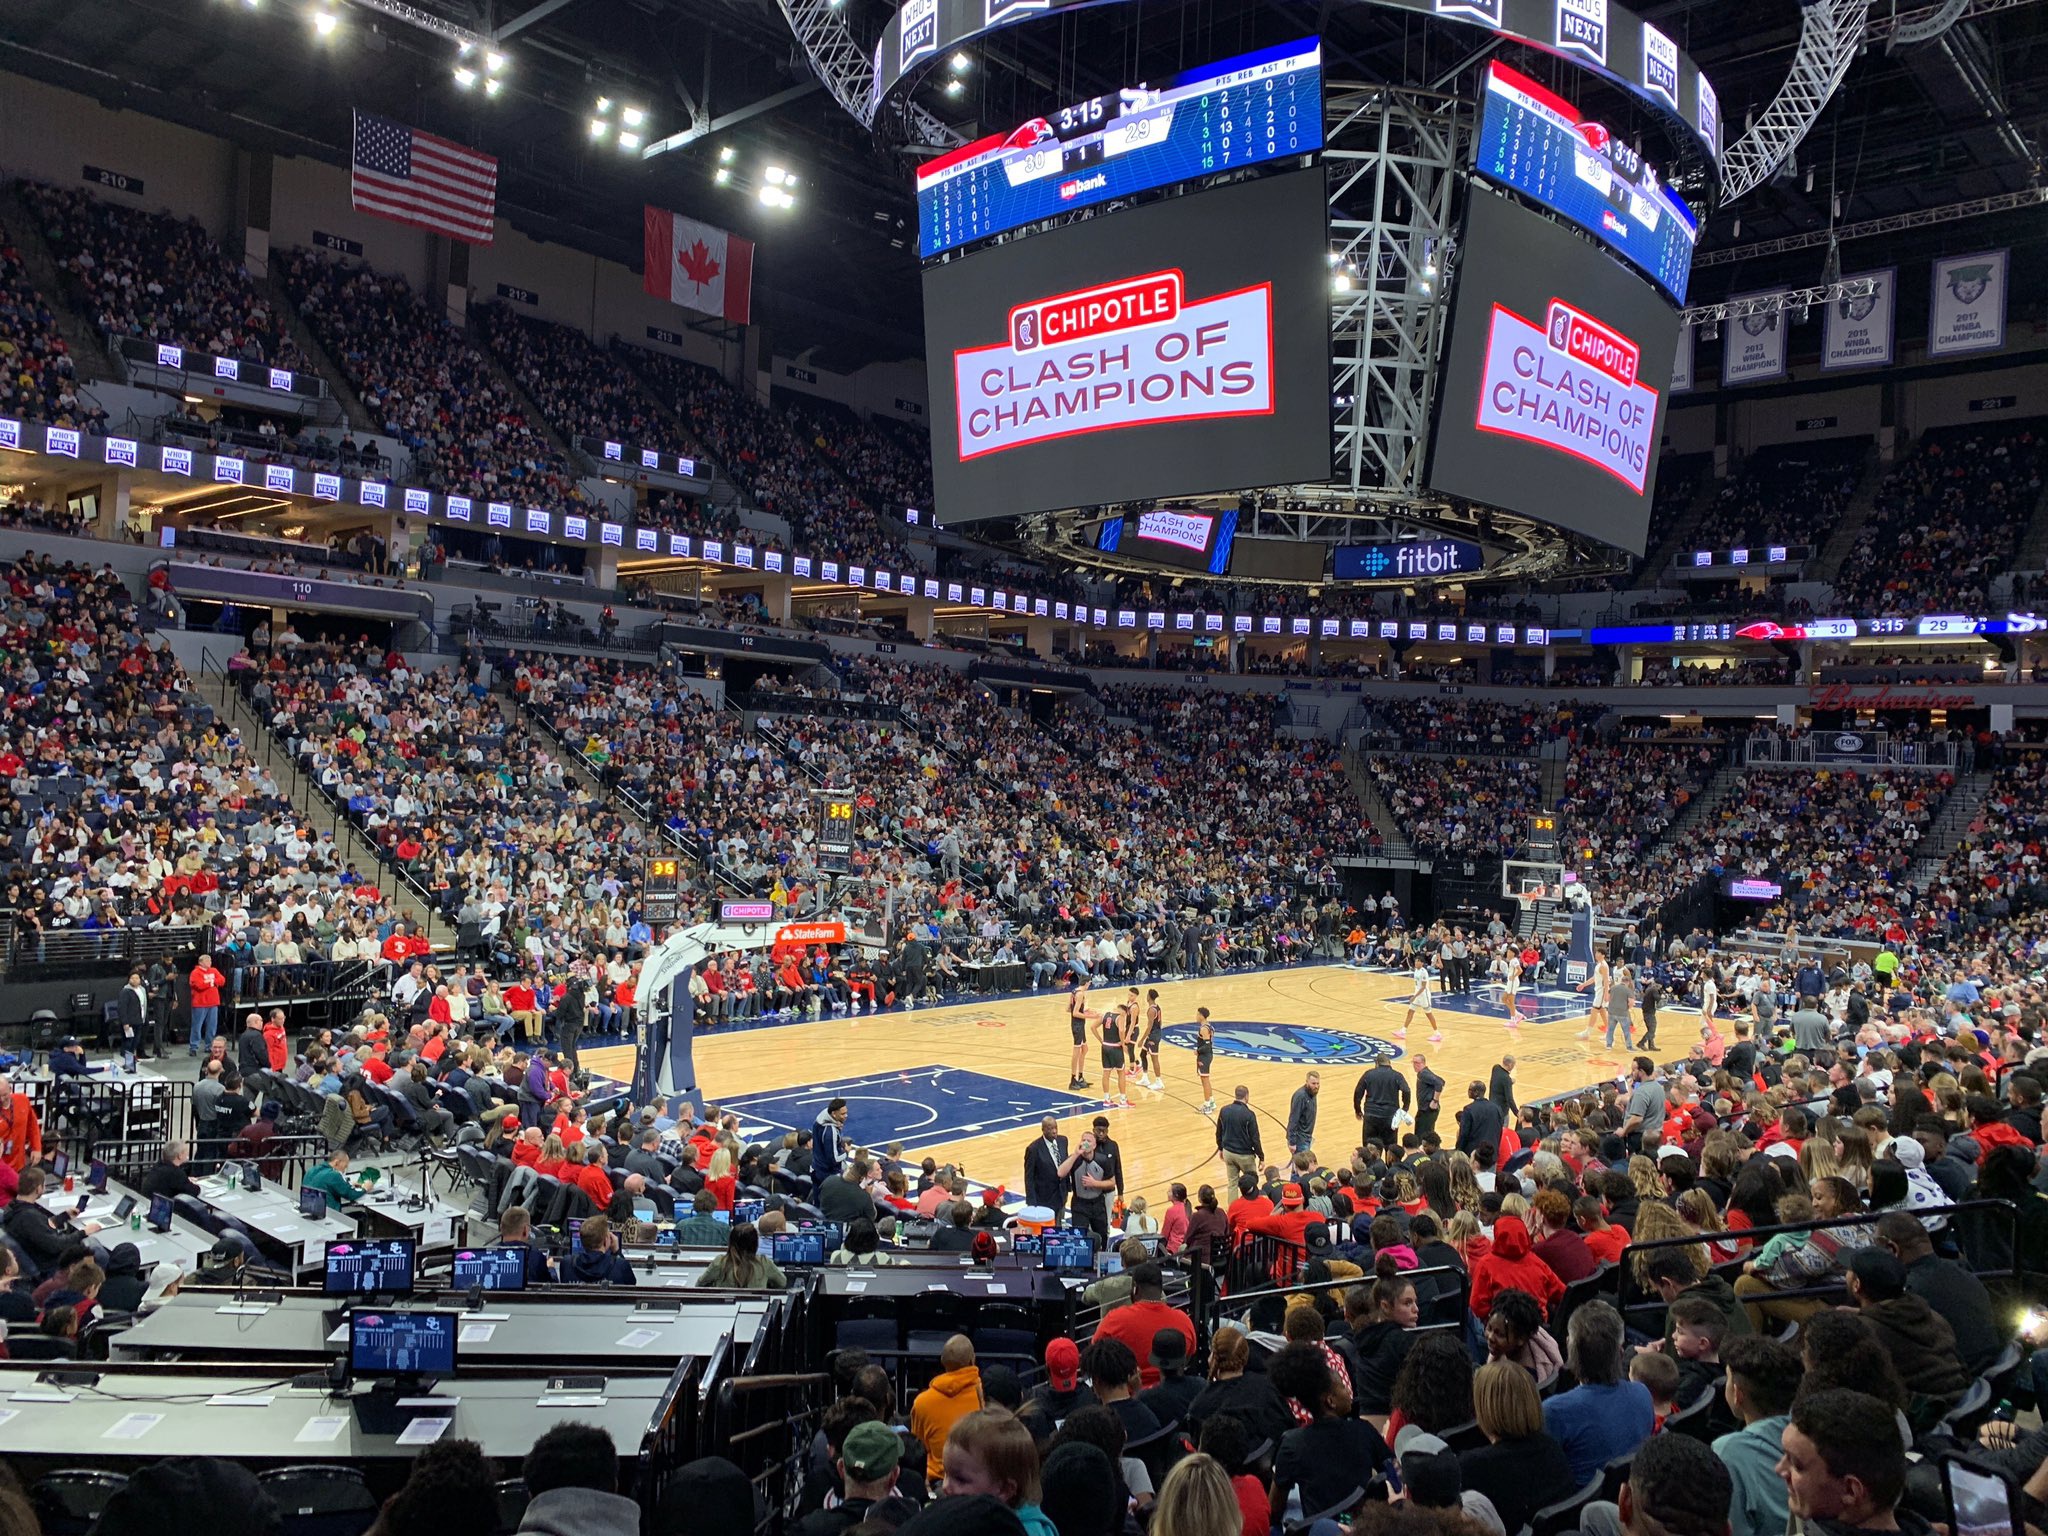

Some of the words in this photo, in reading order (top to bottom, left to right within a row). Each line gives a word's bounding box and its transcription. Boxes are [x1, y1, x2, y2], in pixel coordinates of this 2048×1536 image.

[904, 18, 932, 52] NEXT
[1564, 14, 1601, 45] NEXT
[1650, 32, 1674, 63] WHO'S
[1216, 76, 1232, 86] PTS
[1238, 69, 1253, 80] REB
[1262, 63, 1278, 74] AST
[1286, 58, 1296, 68] PF
[1649, 58, 1674, 90] NEXT
[1201, 96, 1208, 108] 0
[1221, 91, 1229, 103] 2
[1245, 85, 1249, 96] 1
[1266, 79, 1273, 91] 0
[1288, 74, 1295, 85] 0
[1060, 96, 1103, 129] 3:15
[1203, 112, 1208, 123] 1
[1222, 106, 1229, 118] 0
[1244, 101, 1251, 112] 7
[1267, 95, 1272, 107] 1
[1290, 90, 1295, 101] 1
[1203, 127, 1209, 138] 3
[1220, 121, 1232, 134] 13
[1245, 116, 1251, 127] 4
[1266, 111, 1274, 123] 2
[1289, 106, 1296, 117] 0
[1125, 118, 1150, 144] 29
[1202, 141, 1212, 153] 11
[1222, 137, 1229, 149] 0
[1246, 132, 1252, 143] 3
[1267, 126, 1275, 138] 0
[1289, 121, 1296, 132] 0
[1064, 142, 1072, 150] TO
[1092, 133, 1102, 141] TO
[1065, 151, 1070, 160] 3
[1080, 146, 1085, 160] 1
[1097, 142, 1102, 151] 3
[1202, 156, 1213, 169] 15
[1223, 152, 1230, 164] 7
[1246, 147, 1252, 158] 4
[1268, 141, 1275, 154] 0
[1290, 137, 1297, 148] 0
[1615, 140, 1639, 174] 3:15
[954, 164, 962, 172] REB
[967, 158, 977, 166] AST
[1024, 150, 1045, 174] 30
[1588, 156, 1602, 180] 30
[100, 172, 127, 189] 210
[1640, 197, 1651, 221] 29
[327, 236, 348, 250] 211
[509, 288, 528, 300] 212
[1046, 288, 1169, 336] CHIPOTLE
[1956, 312, 1977, 322] 2017
[1953, 321, 1981, 331] WNBA
[657, 331, 672, 342] 213
[1848, 329, 1868, 338] 2015
[1938, 330, 1996, 344] CHAMPIONS
[1746, 344, 1764, 353] 2013
[1845, 338, 1870, 347] WNBA
[980, 344, 1130, 396] CLASH
[1155, 321, 1229, 363] OF
[1572, 327, 1633, 378] CHIPOTLE
[1743, 352, 1766, 362] WNBA
[1830, 346, 1883, 358] CHAMPIONS
[1731, 360, 1777, 374] CHAMPIONS
[1513, 346, 1611, 415] CLASH
[1619, 400, 1644, 429] OF
[969, 362, 1255, 438] CHAMPIONS
[1492, 380, 1644, 472] CHAMPIONS
[1808, 419, 1825, 429] 220
[52, 431, 74, 440] WHO'S
[51, 440, 74, 450] NEXT
[111, 441, 133, 450] WHO'S
[110, 450, 132, 460] NEXT
[167, 450, 187, 459] WHO'S
[166, 460, 188, 469] NEXT
[220, 459, 240, 468] WHO'S
[220, 469, 239, 478] NEXT
[270, 468, 290, 476] WHO'S
[270, 478, 289, 486] NEXT
[1144, 514, 1183, 528] CLASH
[1188, 521, 1203, 531] OF
[1138, 522, 1204, 544] CHAMPIONS
[293, 583, 312, 593] 110
[1831, 624, 1847, 634] 30
[1871, 620, 1904, 632] 3:15
[1930, 621, 1948, 631] 29
[1809, 684, 1975, 710] Budweiser
[830, 804, 850, 818] 3:15
[827, 845, 849, 853] TISSOT
[734, 906, 770, 915] CHIPOTLE
